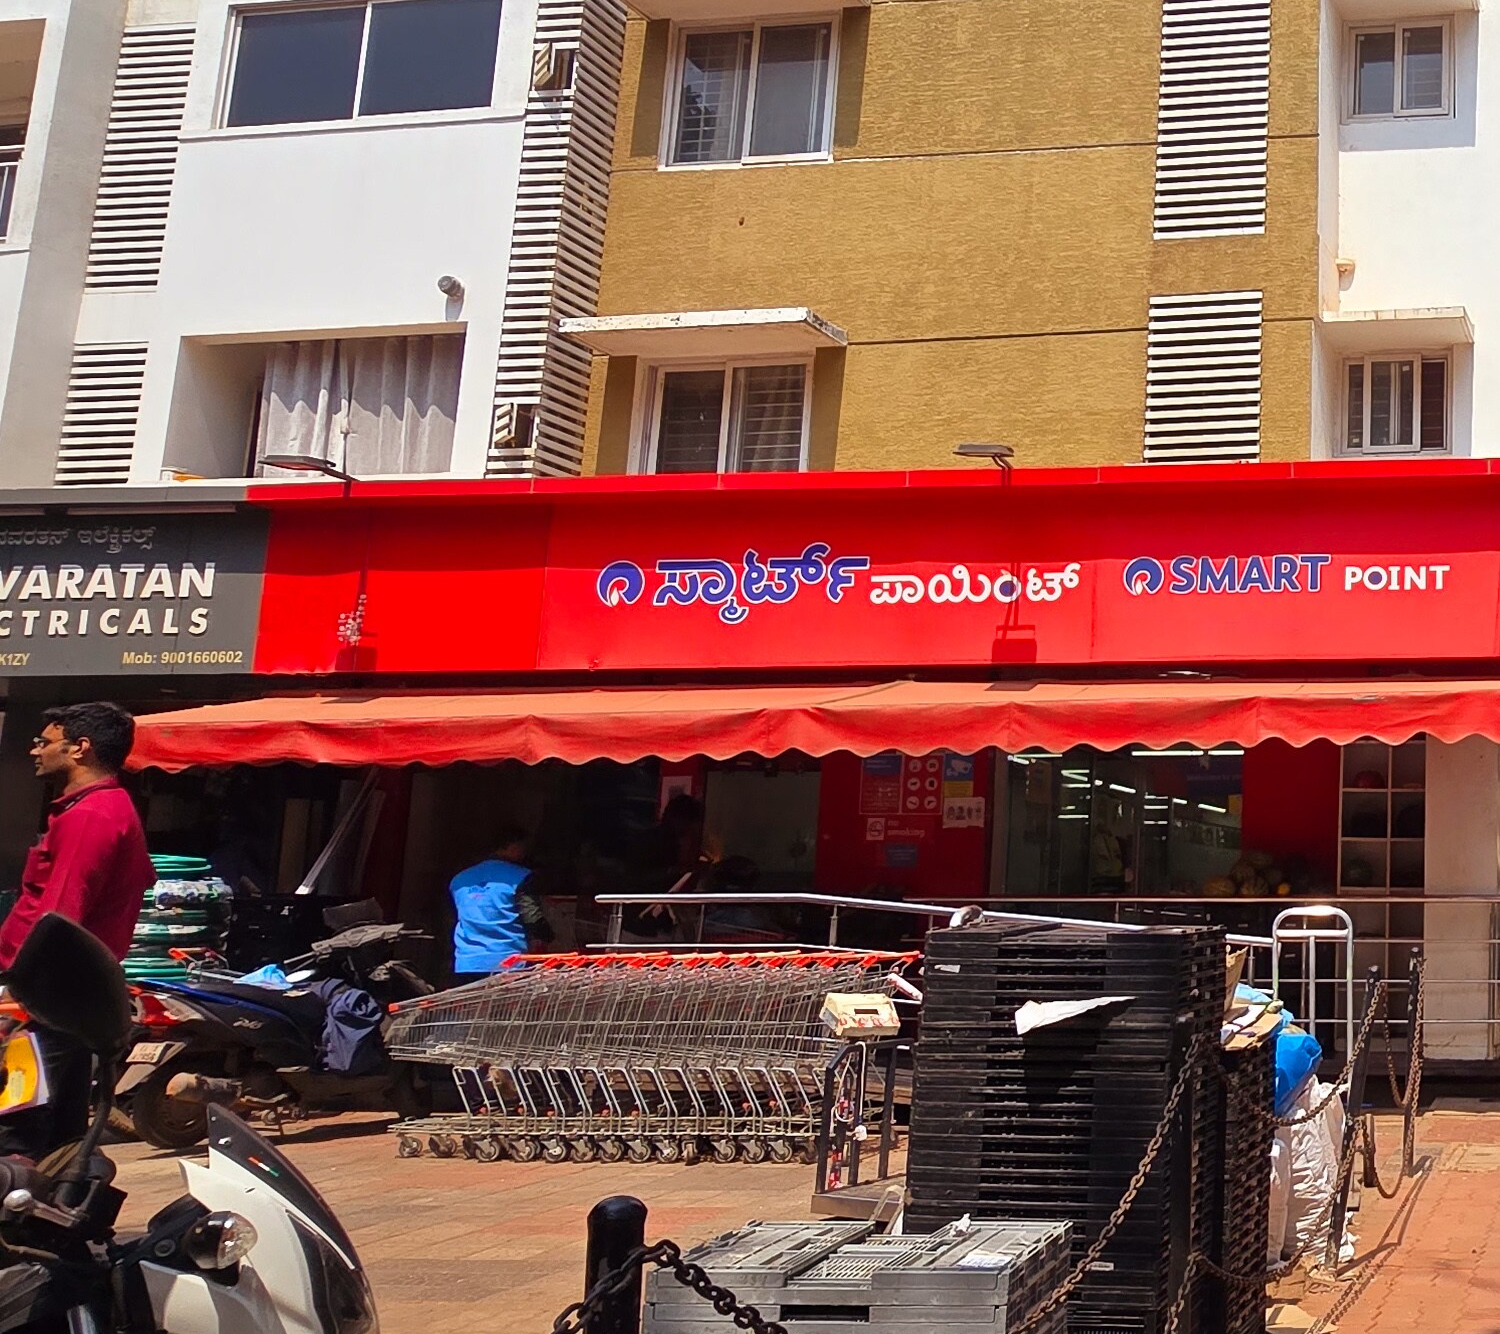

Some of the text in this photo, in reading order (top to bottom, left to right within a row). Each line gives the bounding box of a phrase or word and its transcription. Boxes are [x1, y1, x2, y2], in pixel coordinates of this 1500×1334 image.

[1169, 554, 1450, 594] SMART POINT
[122, 652, 157, 665] Mob:
[160, 651, 243, 664] 9001660602
